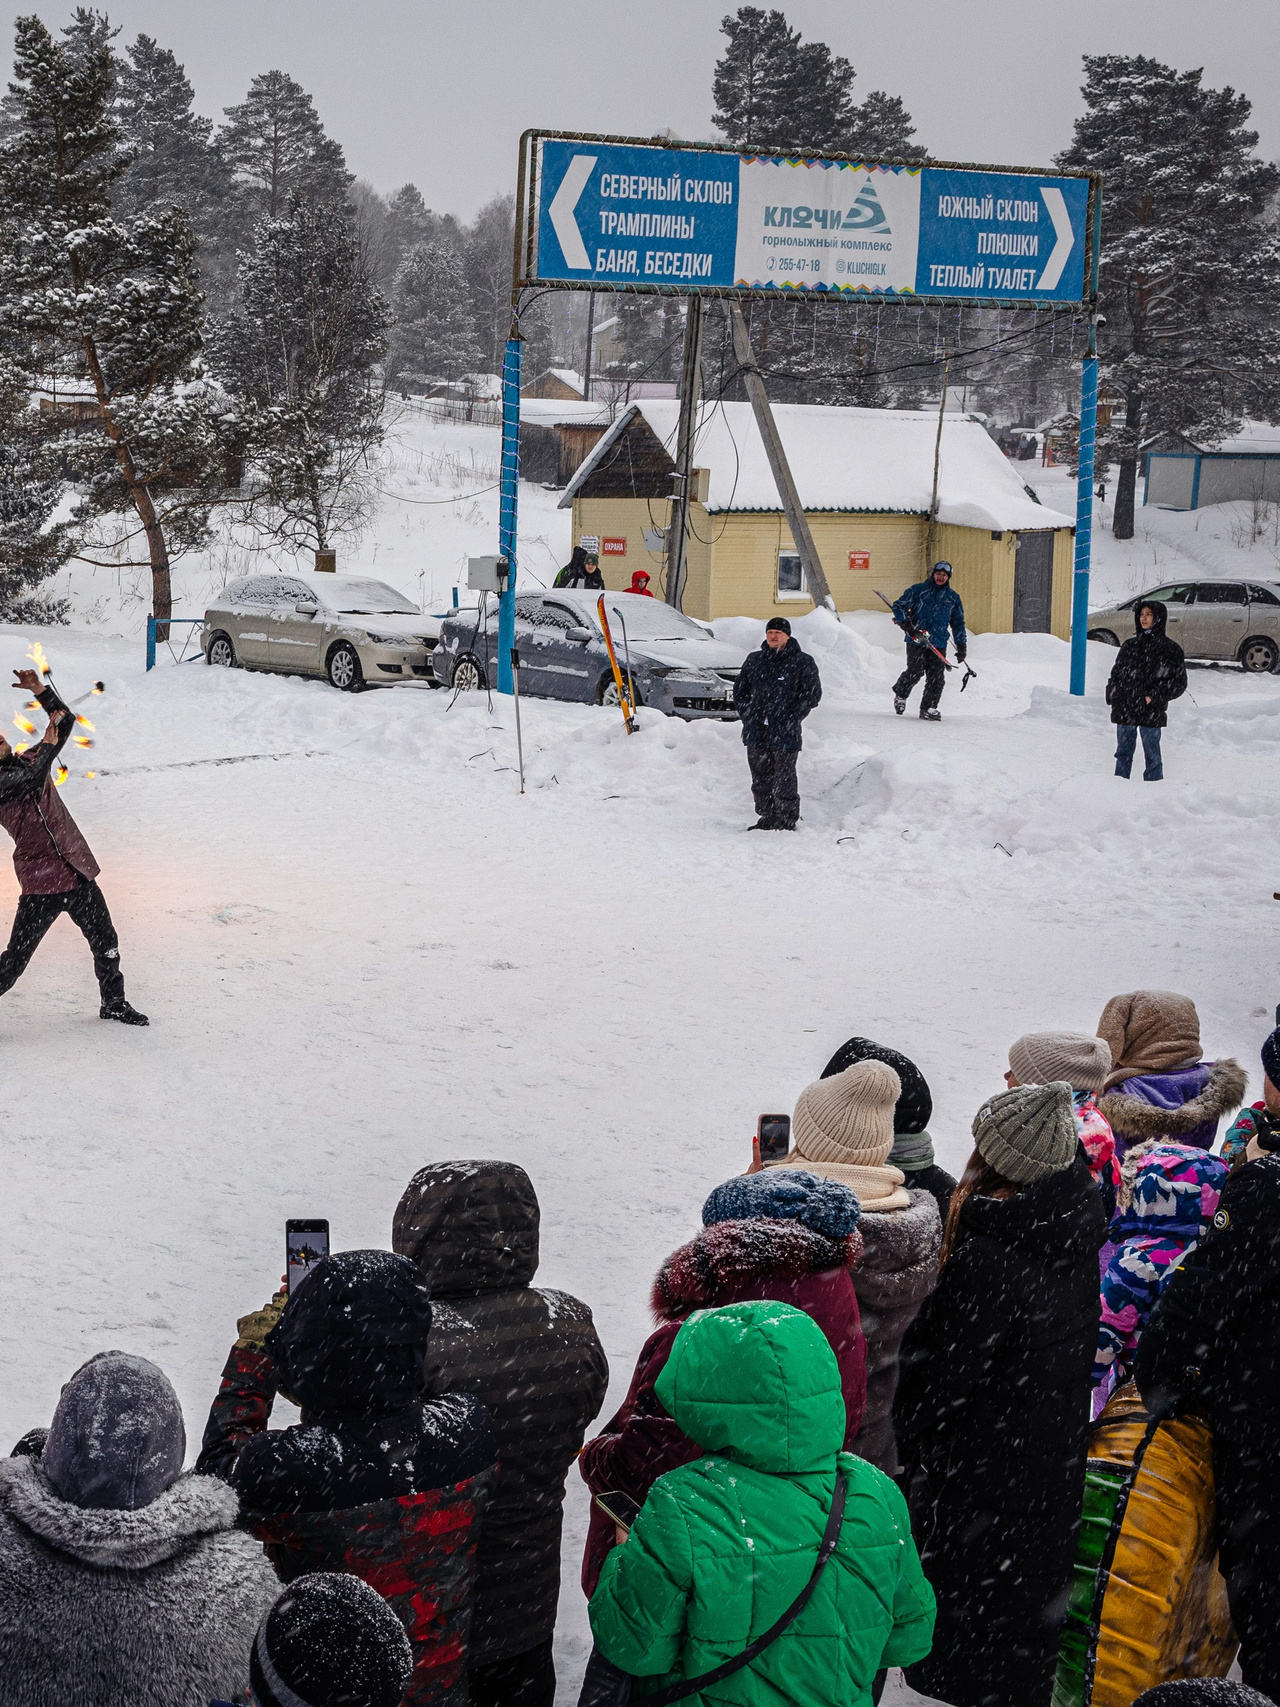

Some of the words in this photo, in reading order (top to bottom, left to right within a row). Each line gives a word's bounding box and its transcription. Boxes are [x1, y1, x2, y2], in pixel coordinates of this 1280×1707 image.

[600, 173, 681, 201] СЕВЕРНЫЙ
[684, 179, 732, 204] СКЛОН
[938, 194, 993, 220] ЮЖНЫЙ
[996, 199, 1038, 222] СКЛОН
[599, 211, 695, 239] ТРАМПЛИНЫ
[762, 235, 838, 248] горнолыжный
[840, 240, 892, 251] комплекс
[977, 232, 1038, 256] ПЛЮШКИ
[595, 248, 640, 276] БАНЯ,
[644, 251, 713, 278] БЕСЕДКИ
[779, 258, 820, 272] 255-47-18
[847, 261, 886, 275] KLUCHIGLK
[929, 262, 984, 288] ТЕПЛЫЙ
[987, 268, 1036, 290] ТУАЛЕТ
[604, 543, 623, 551] ОХРАНА
